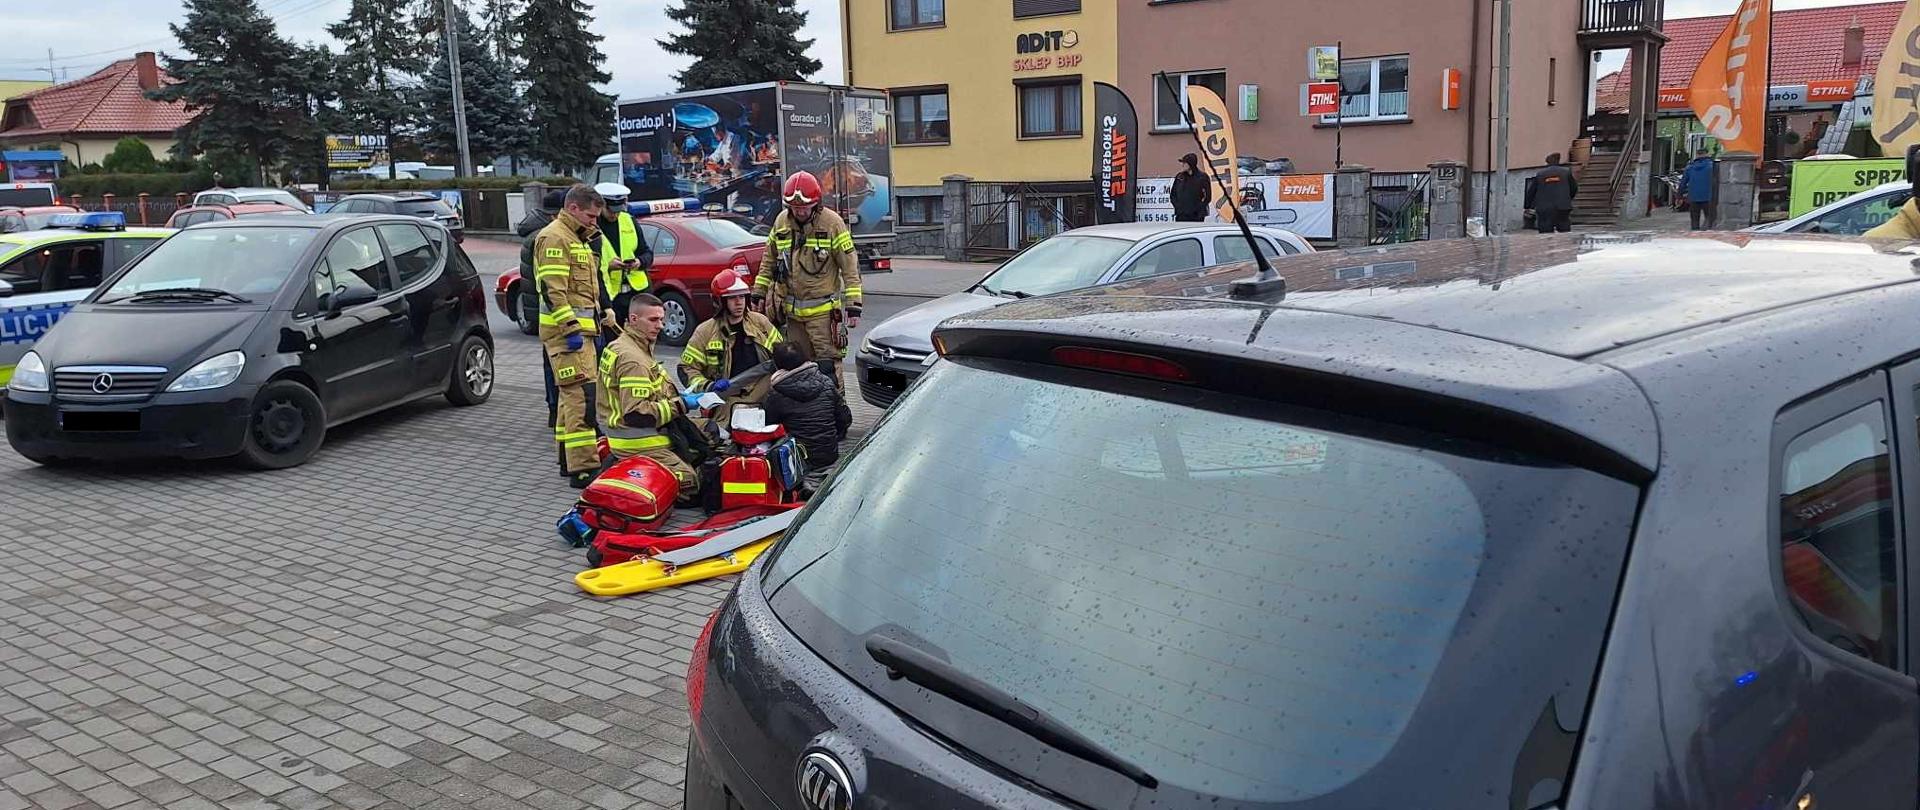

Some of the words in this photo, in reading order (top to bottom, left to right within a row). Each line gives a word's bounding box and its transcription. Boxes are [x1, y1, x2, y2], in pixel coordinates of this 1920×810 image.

[1014, 56, 1051, 71] SKLEP
[1057, 53, 1083, 68] BHP
[1768, 91, 1798, 101] GRÓD
[1812, 86, 1850, 96] STIHL
[1309, 92, 1337, 106] STIHL
[1657, 94, 1685, 102] TIHL
[620, 113, 664, 131] dorado.pl
[790, 113, 822, 124] dorado.pl
[1440, 168, 1455, 177] 12
[1854, 169, 1906, 186] SPRZ
[1136, 186, 1156, 195] KLEP
[1282, 186, 1319, 195] STIHL
[1155, 213, 1169, 222] 545
[0, 311, 65, 338] LICJ
[560, 368, 573, 377] PSP
[801, 760, 839, 810] KIA
